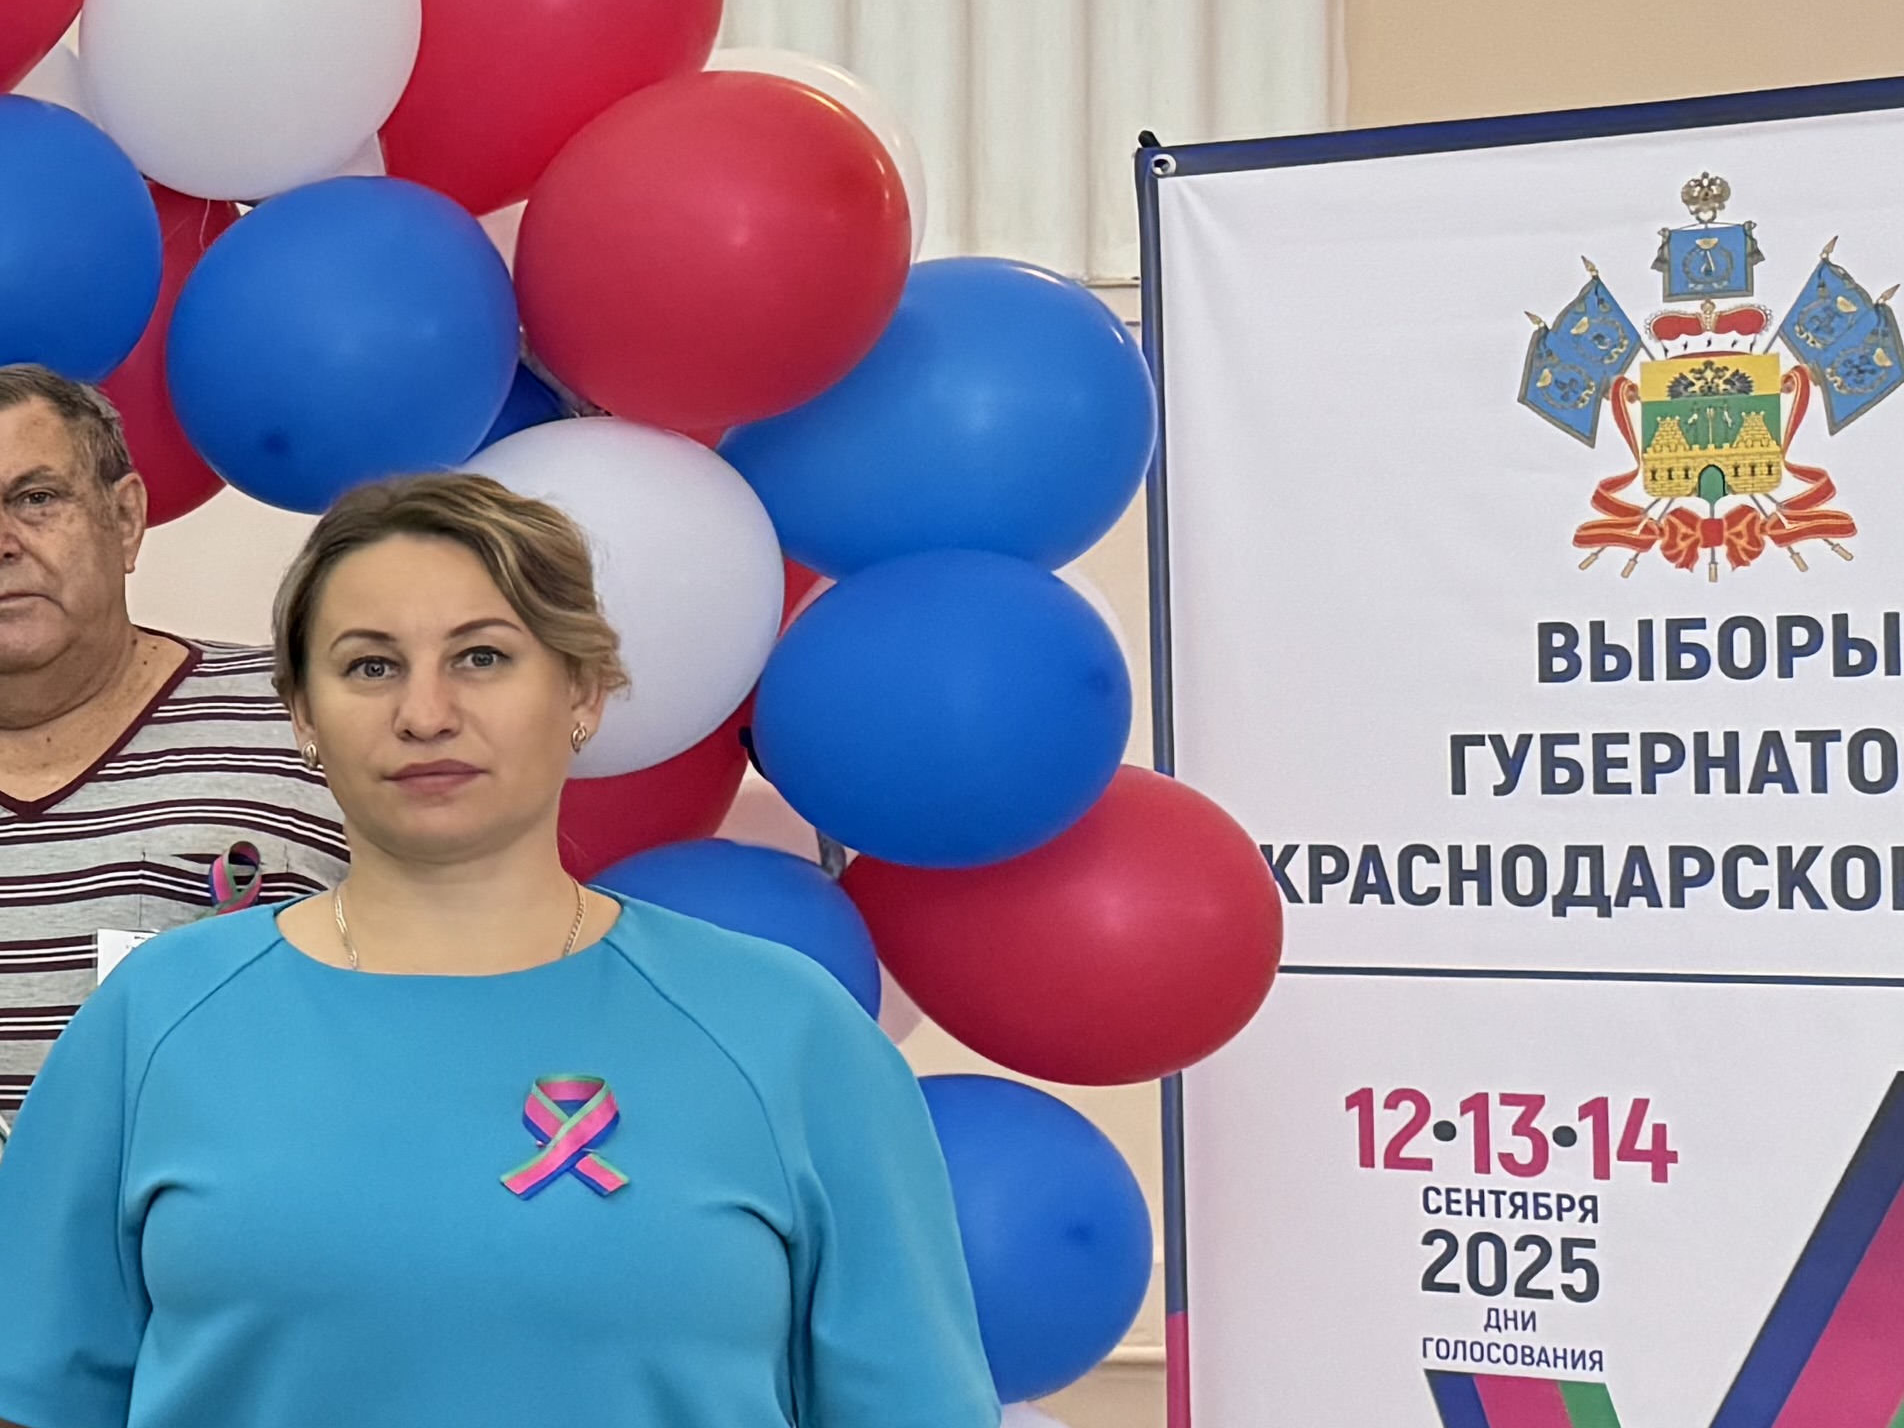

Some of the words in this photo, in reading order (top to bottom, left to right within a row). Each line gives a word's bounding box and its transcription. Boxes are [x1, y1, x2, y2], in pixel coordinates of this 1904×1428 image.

[1538, 612, 1901, 683] ВЫБОРЫ
[1450, 728, 1899, 796] ГУБЕРНАТО
[1259, 843, 1904, 918] КРАСНОДАРСКО
[1422, 1186, 1599, 1224] СЕНТЯБРЯ
[1421, 1229, 1600, 1303] 2025
[1484, 1308, 1537, 1332] ДНИ
[1422, 1338, 1604, 1372] ГОЛОСОВАНИЯ
